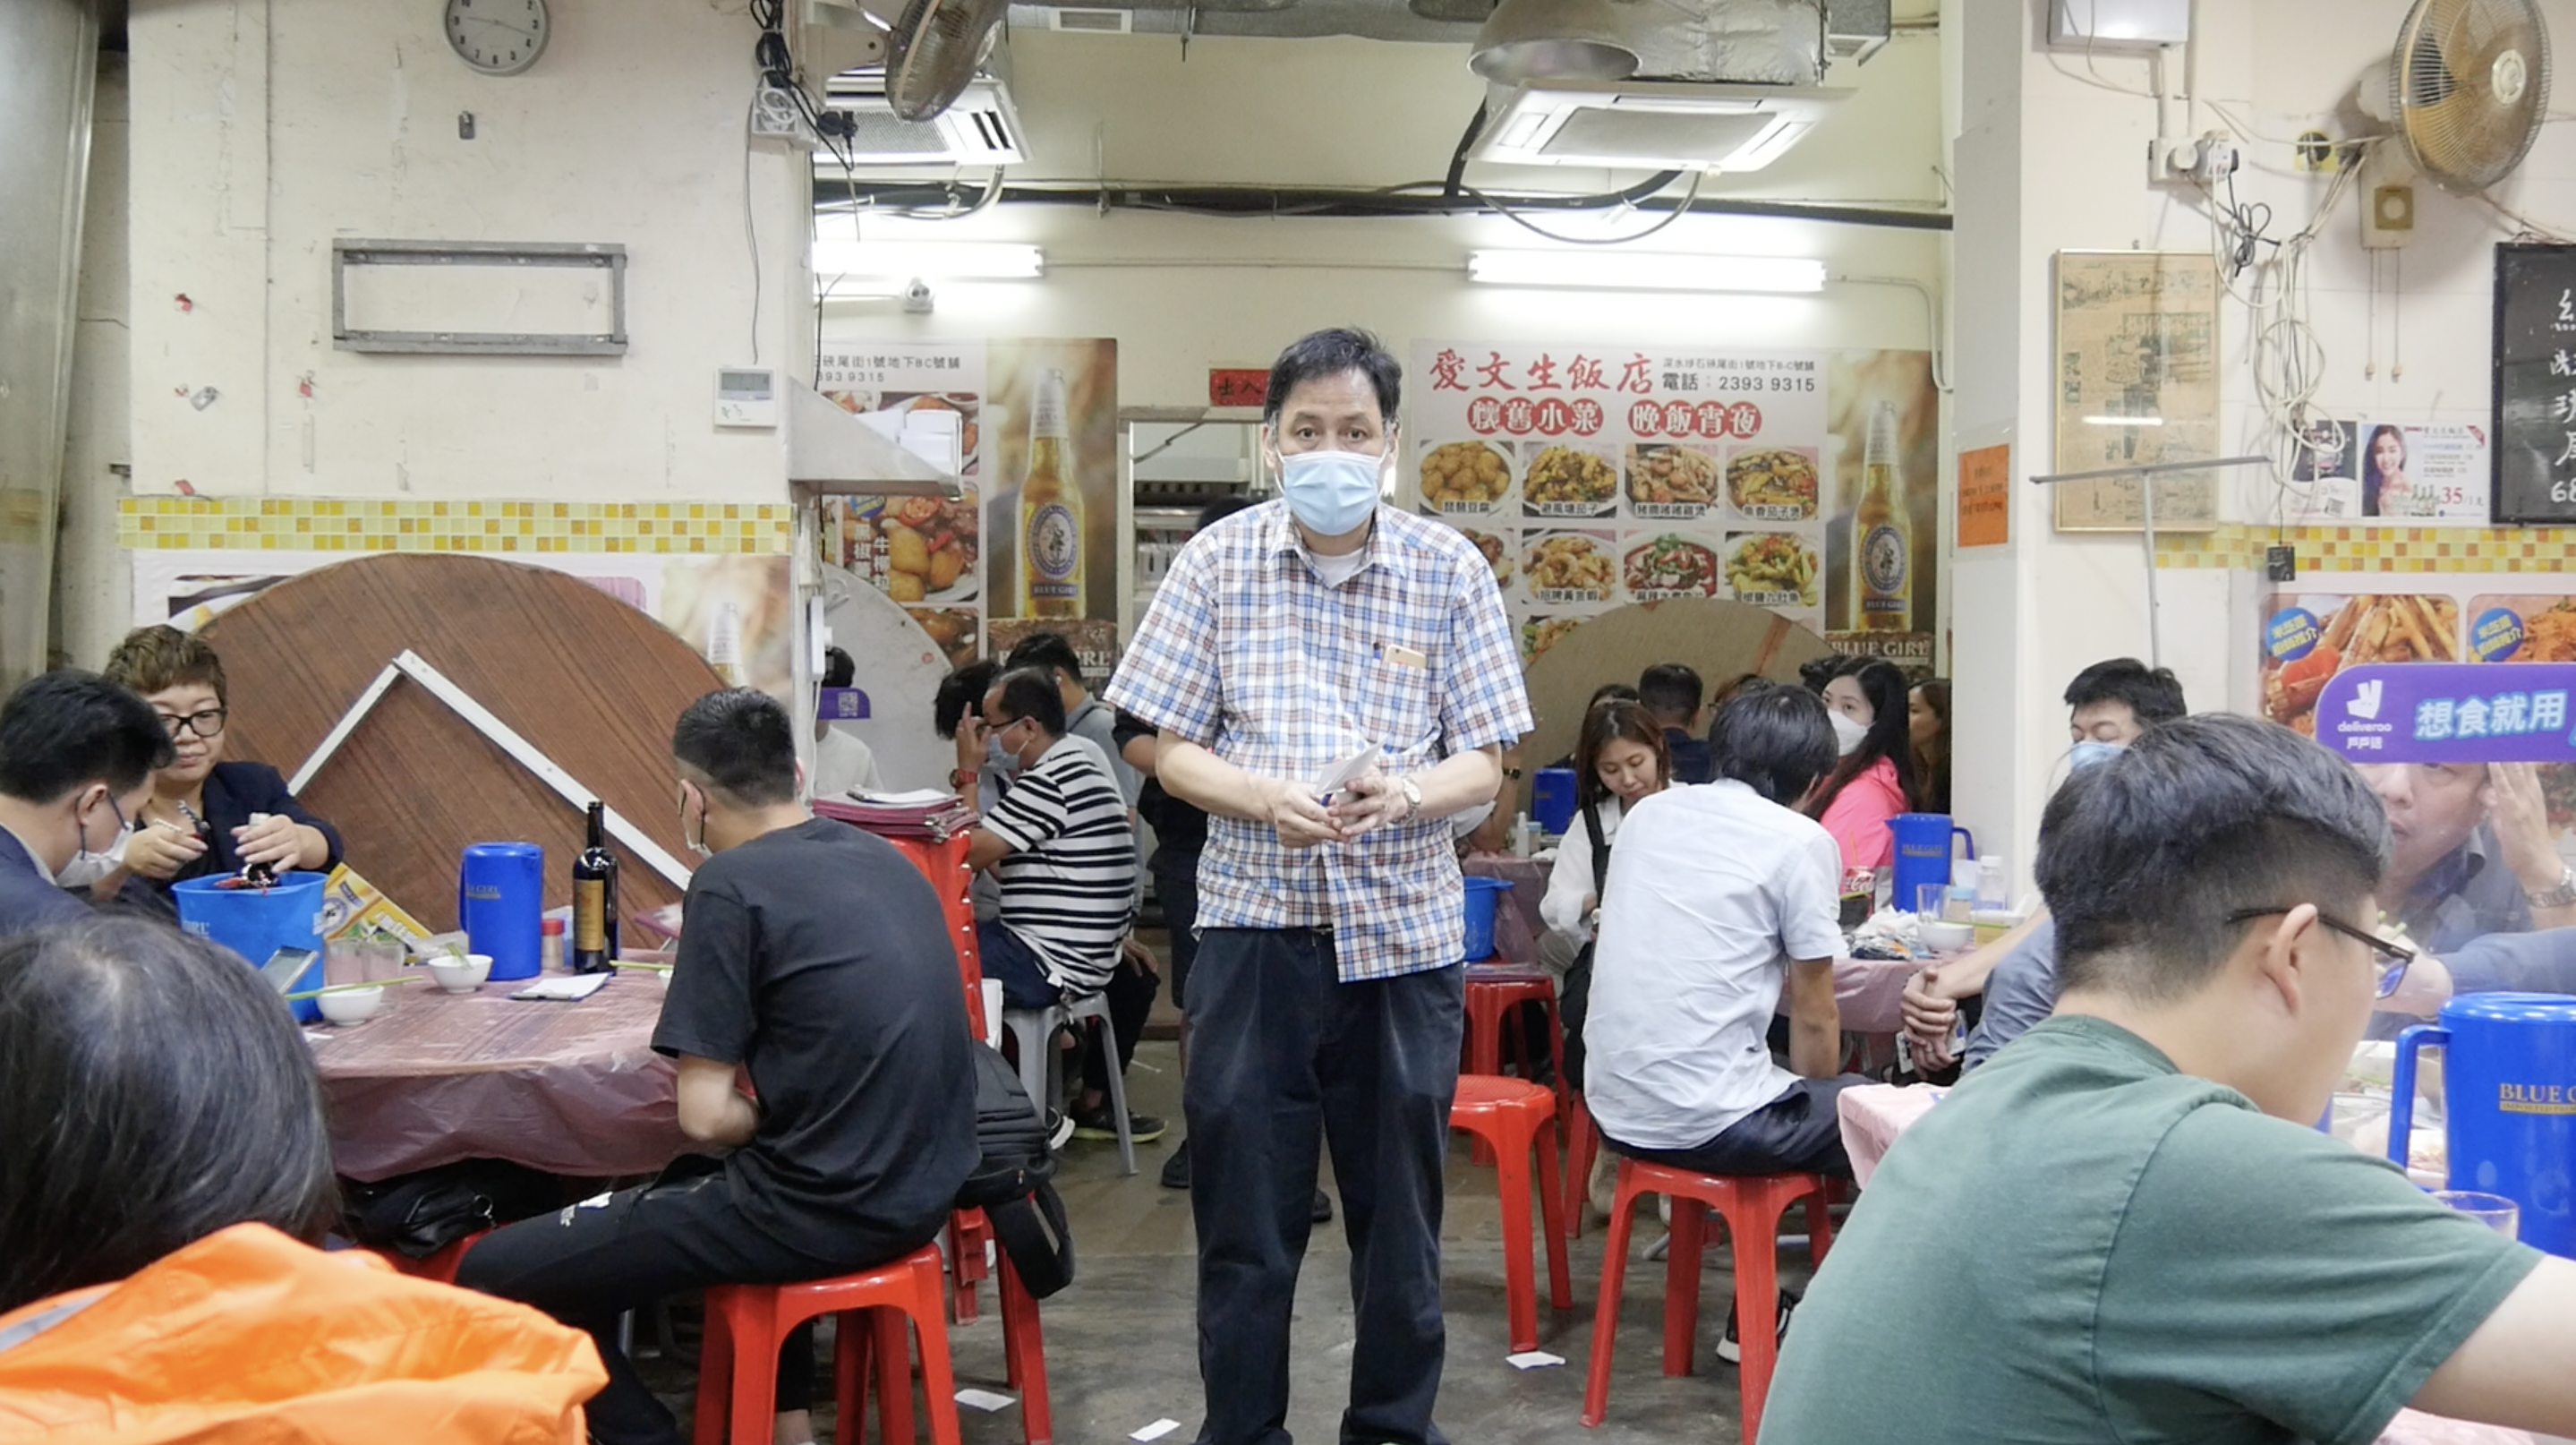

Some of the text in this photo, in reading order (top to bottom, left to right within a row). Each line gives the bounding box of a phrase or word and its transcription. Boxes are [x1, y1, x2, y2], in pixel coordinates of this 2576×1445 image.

[849, 372, 885, 382] 9315
[1429, 347, 1653, 394] 愛文生飯店
[1719, 376, 1763, 391] 2393
[1770, 377, 1815, 392] 9315
[1471, 400, 1759, 436] 懷舊小菜 晚飯宵夜
[1831, 641, 1929, 657] BLUE GIRL
[2416, 692, 2567, 738] 想食就用
[2337, 721, 2393, 732] deliveroo
[2499, 1082, 2562, 1102] BLUE
